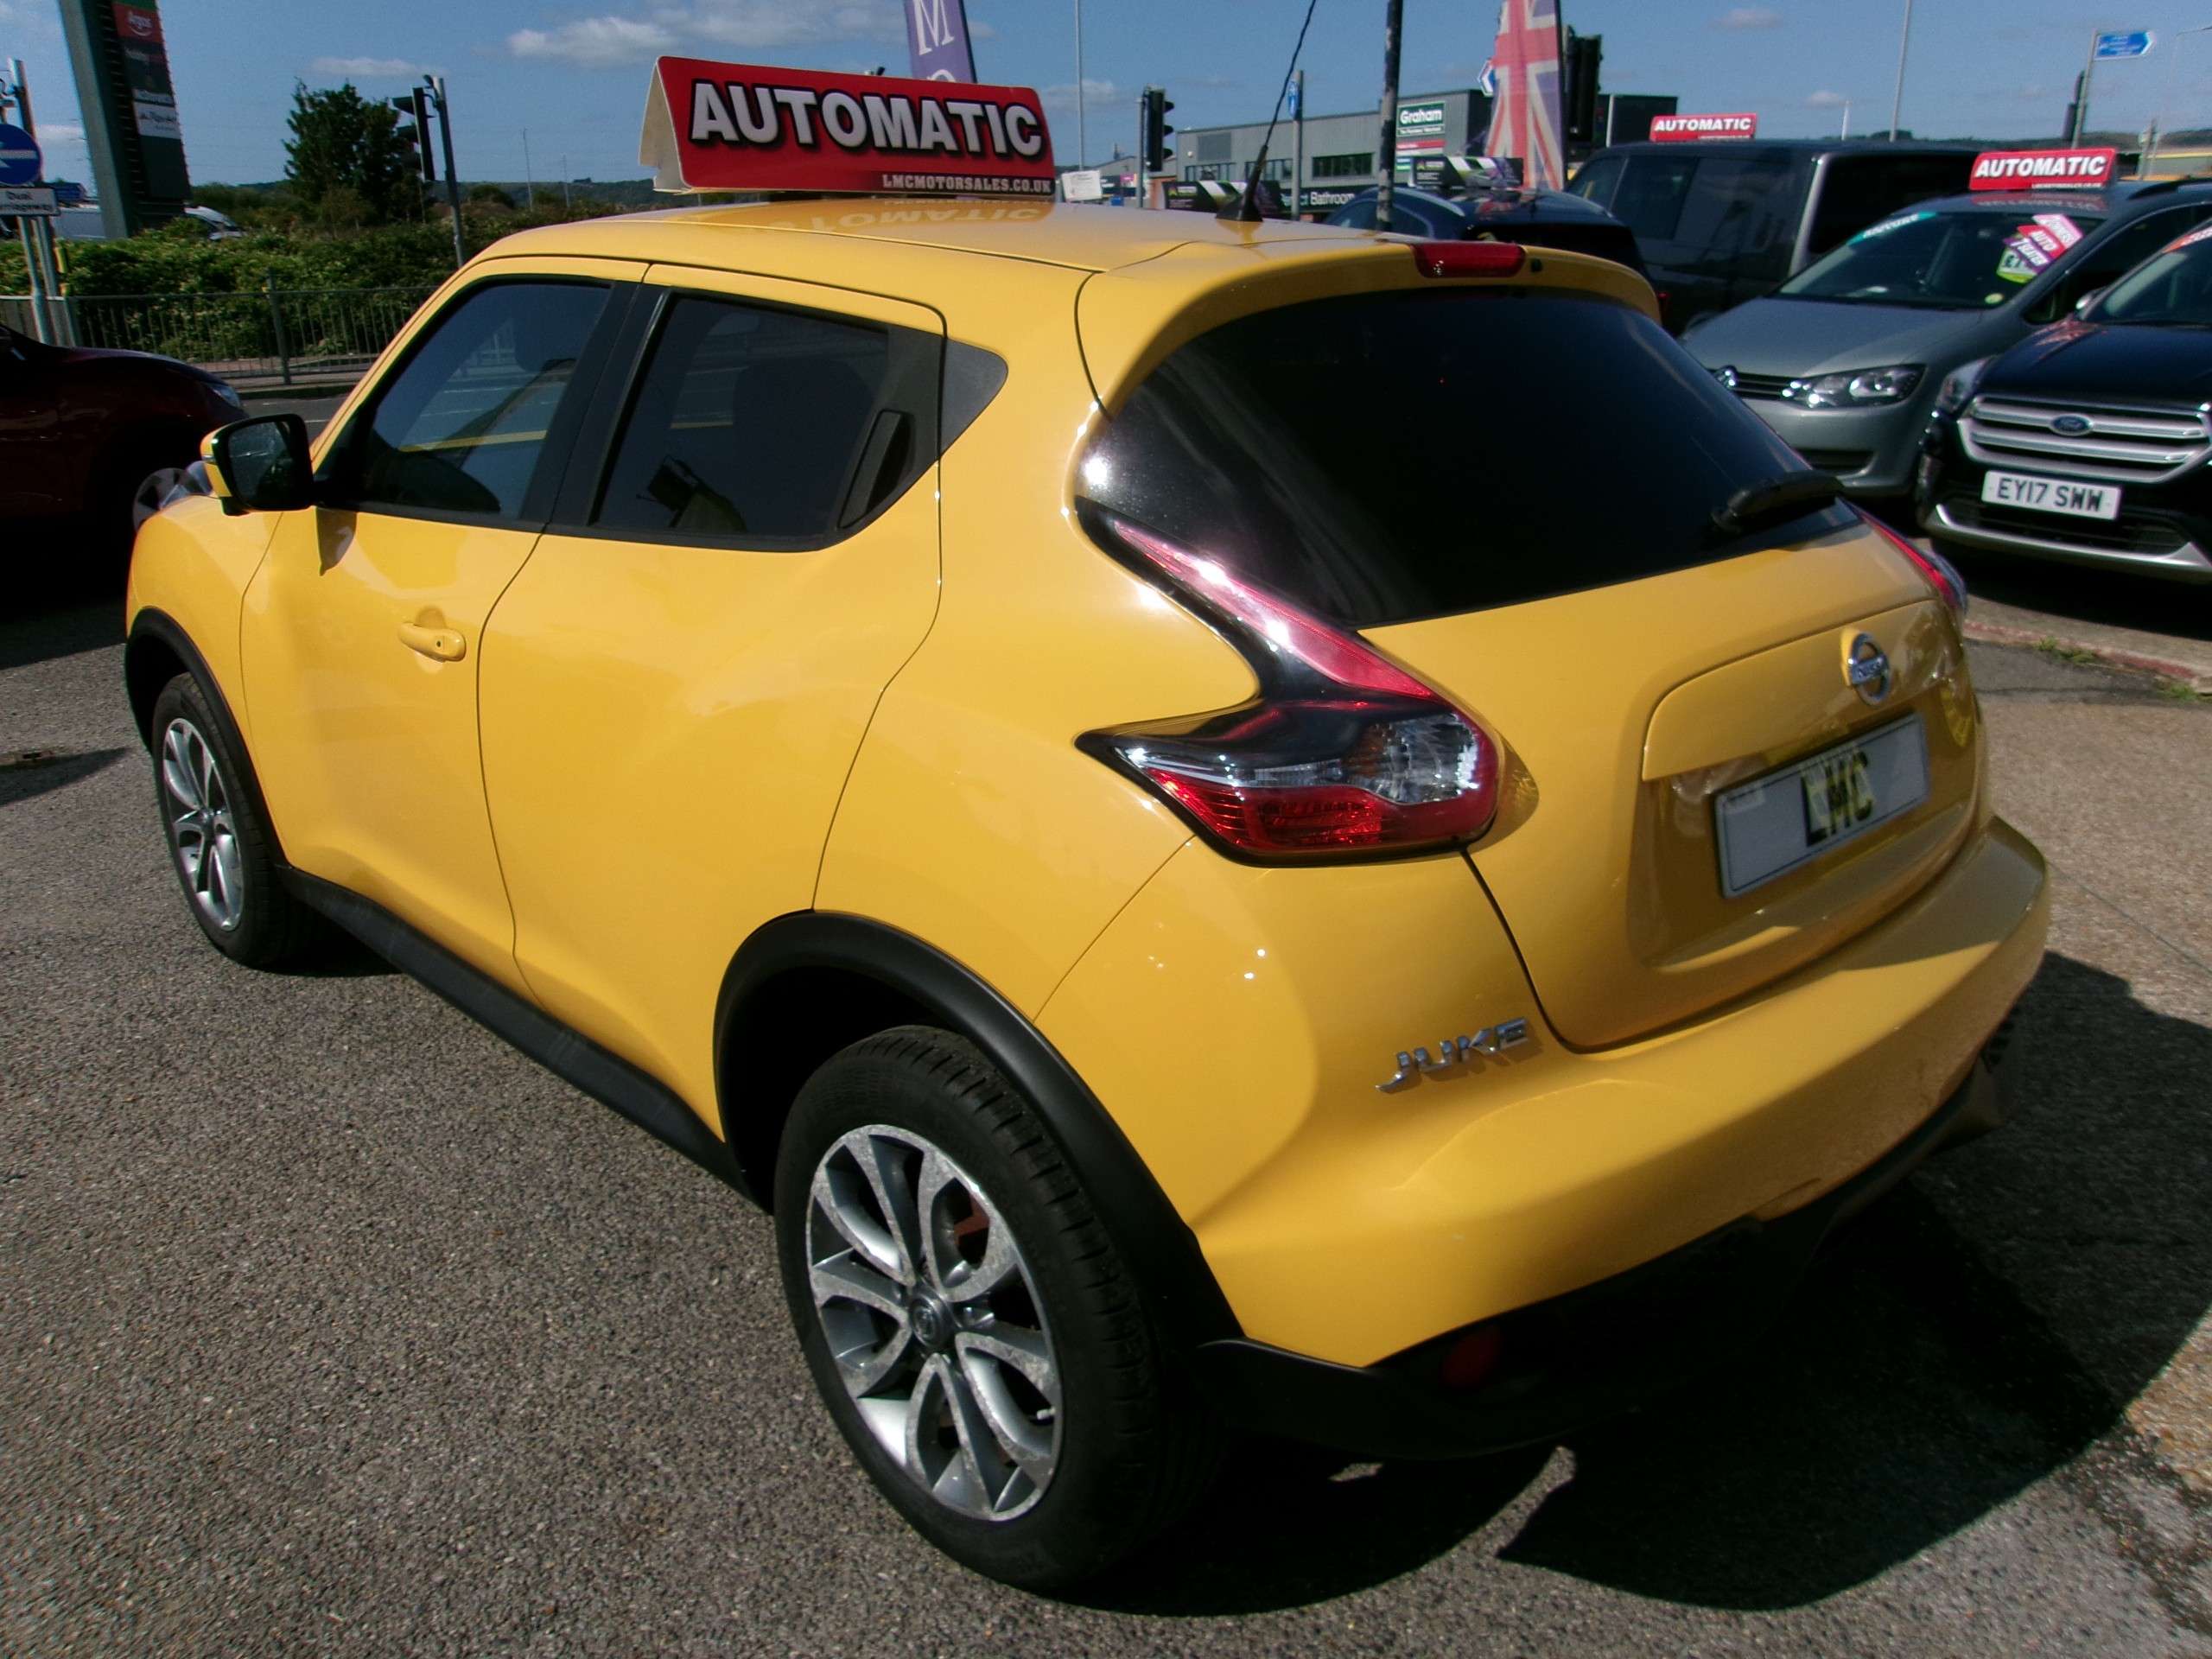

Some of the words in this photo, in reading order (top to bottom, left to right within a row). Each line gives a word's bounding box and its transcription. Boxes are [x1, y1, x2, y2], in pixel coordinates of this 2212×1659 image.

[691, 82, 1043, 157] AUTOMATIC
[1400, 109, 1443, 124] Graham
[1655, 118, 1752, 131] AUTOMATIC
[1974, 156, 2107, 178] AUTOMATIC
[882, 175, 1052, 193] LMCMOTORSALES.CO.UK
[1997, 477, 2049, 504] EY17
[2055, 486, 2103, 512] SWW
[1374, 1017, 1529, 1092] JUKE
